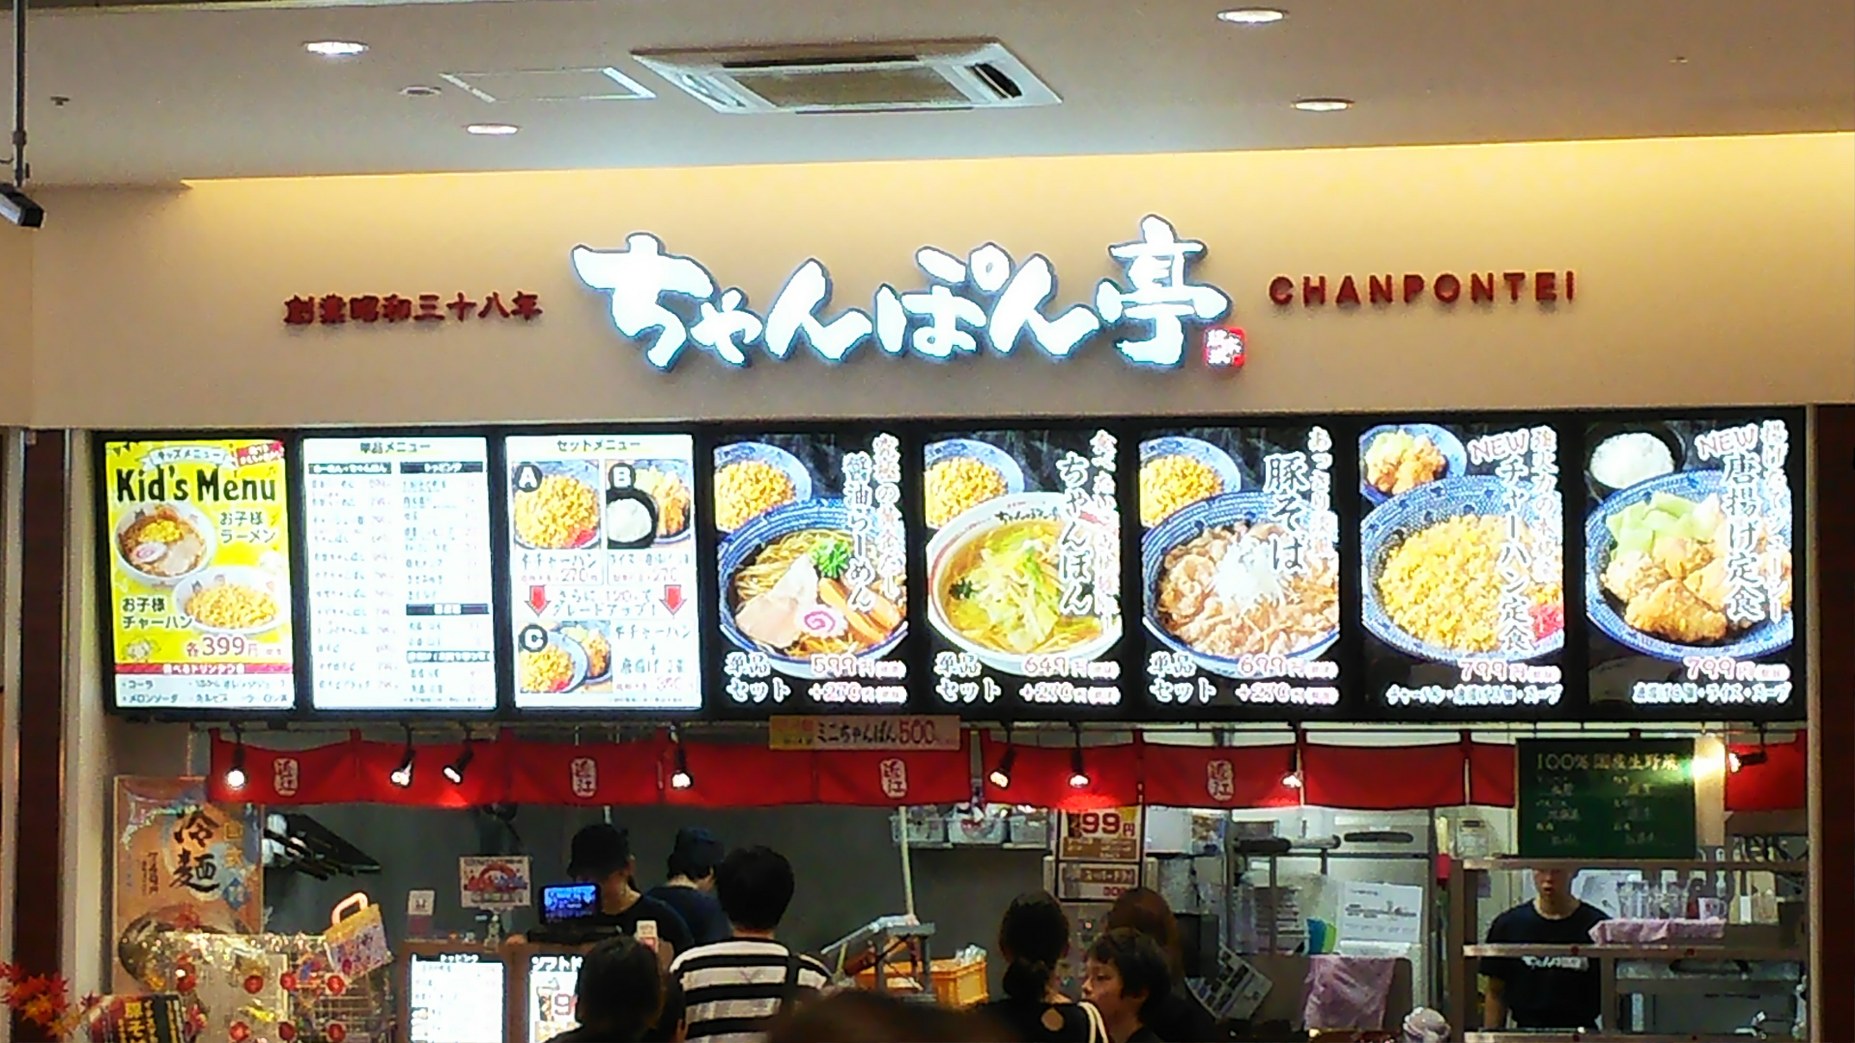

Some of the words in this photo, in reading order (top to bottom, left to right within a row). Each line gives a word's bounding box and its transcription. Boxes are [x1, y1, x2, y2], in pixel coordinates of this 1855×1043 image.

[571, 214, 1232, 371] ちゃんぽん亭
[1268, 270, 1576, 308] CHANPONTEI
[284, 291, 543, 325] 創業昭和三十八年
[557, 439, 641, 453] セットメニュー
[1470, 430, 1528, 462] NEW
[1697, 426, 1757, 458] NEW
[116, 465, 189, 502] Kid's
[197, 467, 276, 502] Menu
[518, 467, 538, 489] A
[612, 466, 632, 488] B
[220, 511, 264, 526] お子様
[1265, 454, 1307, 573] 豚そば
[220, 530, 277, 544] ラーメン
[1059, 453, 1092, 614] ちゃんぽん
[1724, 455, 1765, 620] 唐揚げ定食
[1497, 456, 1533, 654] チャーハン定食
[122, 596, 166, 612] お子様
[123, 615, 193, 629] チャーハン
[524, 629, 544, 650] C
[728, 679, 789, 701] セット
[937, 679, 1000, 702] セット
[1151, 679, 1215, 702] セット
[275, 759, 297, 796] 近江
[572, 759, 596, 798] 近江
[881, 760, 906, 798] 近江
[1208, 760, 1232, 800] 近江
